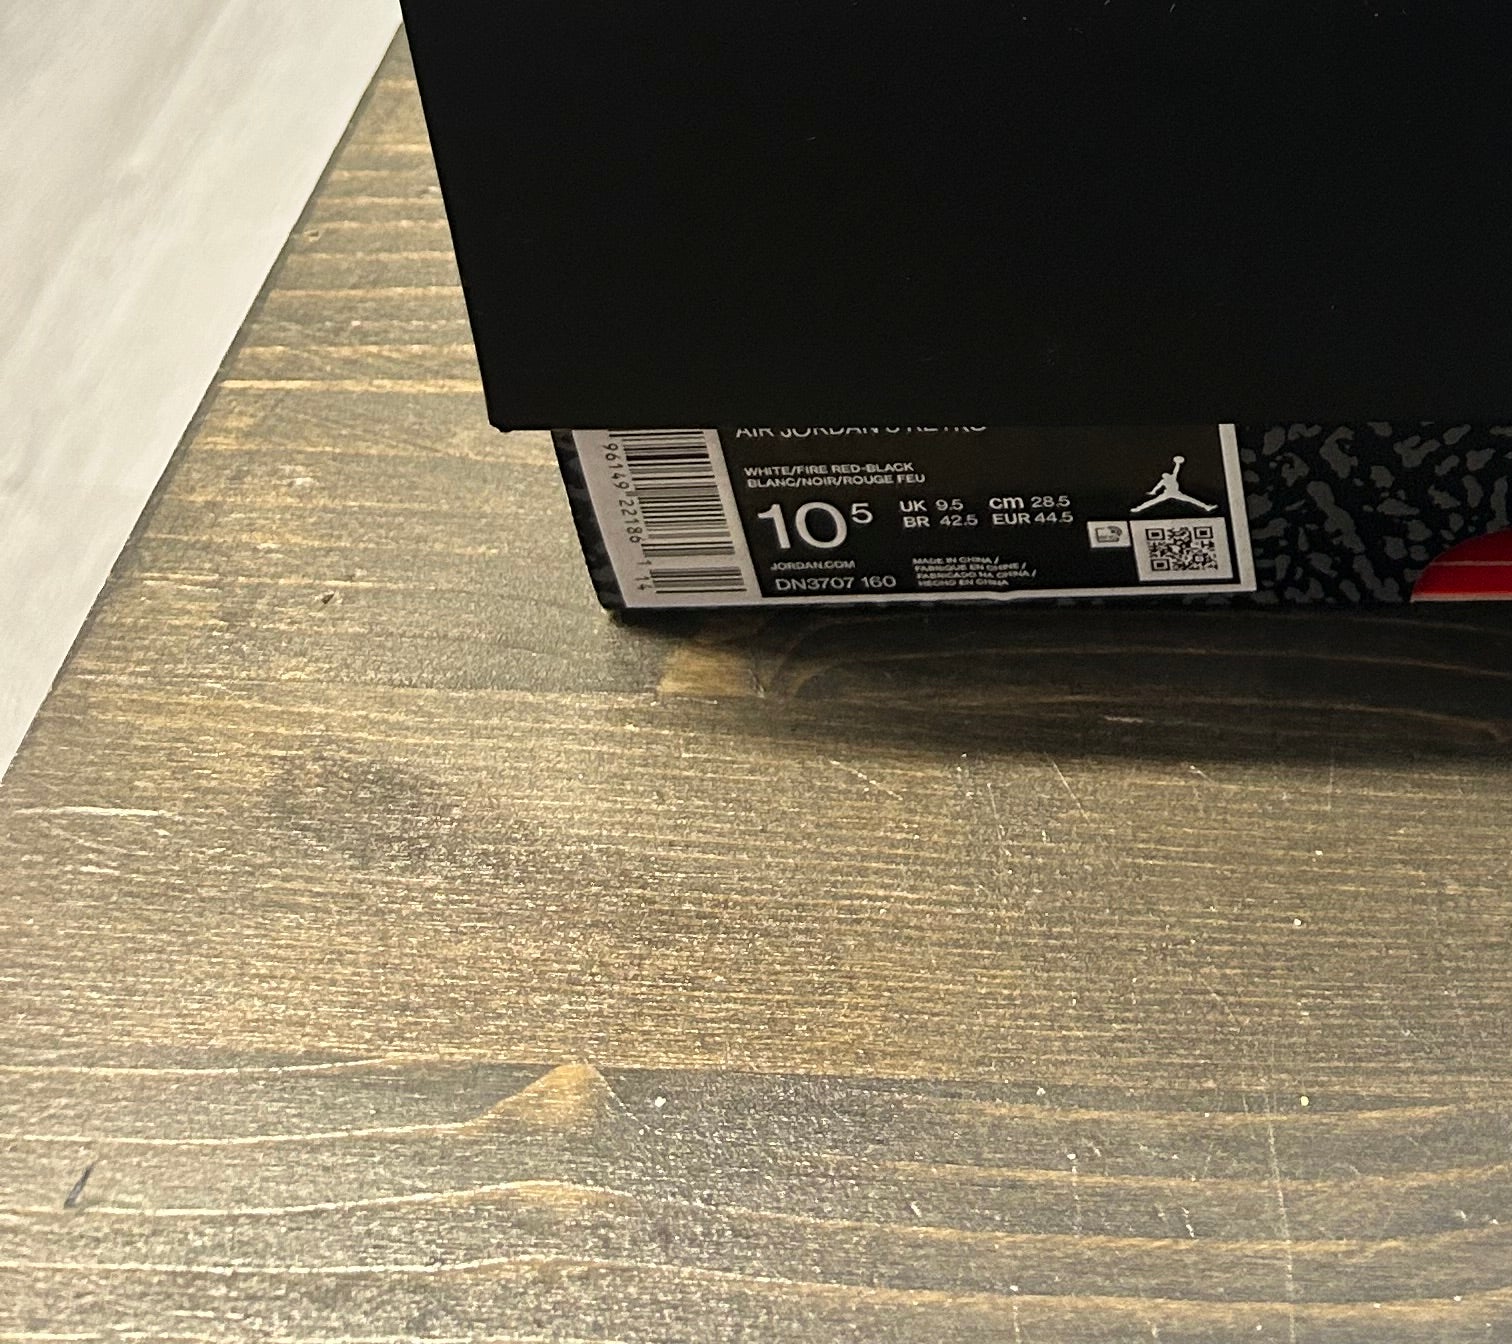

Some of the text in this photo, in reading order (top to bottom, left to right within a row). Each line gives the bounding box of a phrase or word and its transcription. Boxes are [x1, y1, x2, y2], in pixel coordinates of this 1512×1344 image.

[744, 462, 915, 477] WHITE/FIRE RED-BLACK
[747, 474, 926, 488] BLANC/NOIR/ROUGE FEU
[900, 499, 927, 513] UK
[935, 498, 964, 512] 9.5
[1031, 495, 1071, 509] 28.5
[903, 511, 1074, 529] BR 42.5 EUR 44.5
[770, 560, 856, 572] JORDAN.COM
[775, 575, 897, 592] DN3707 160
